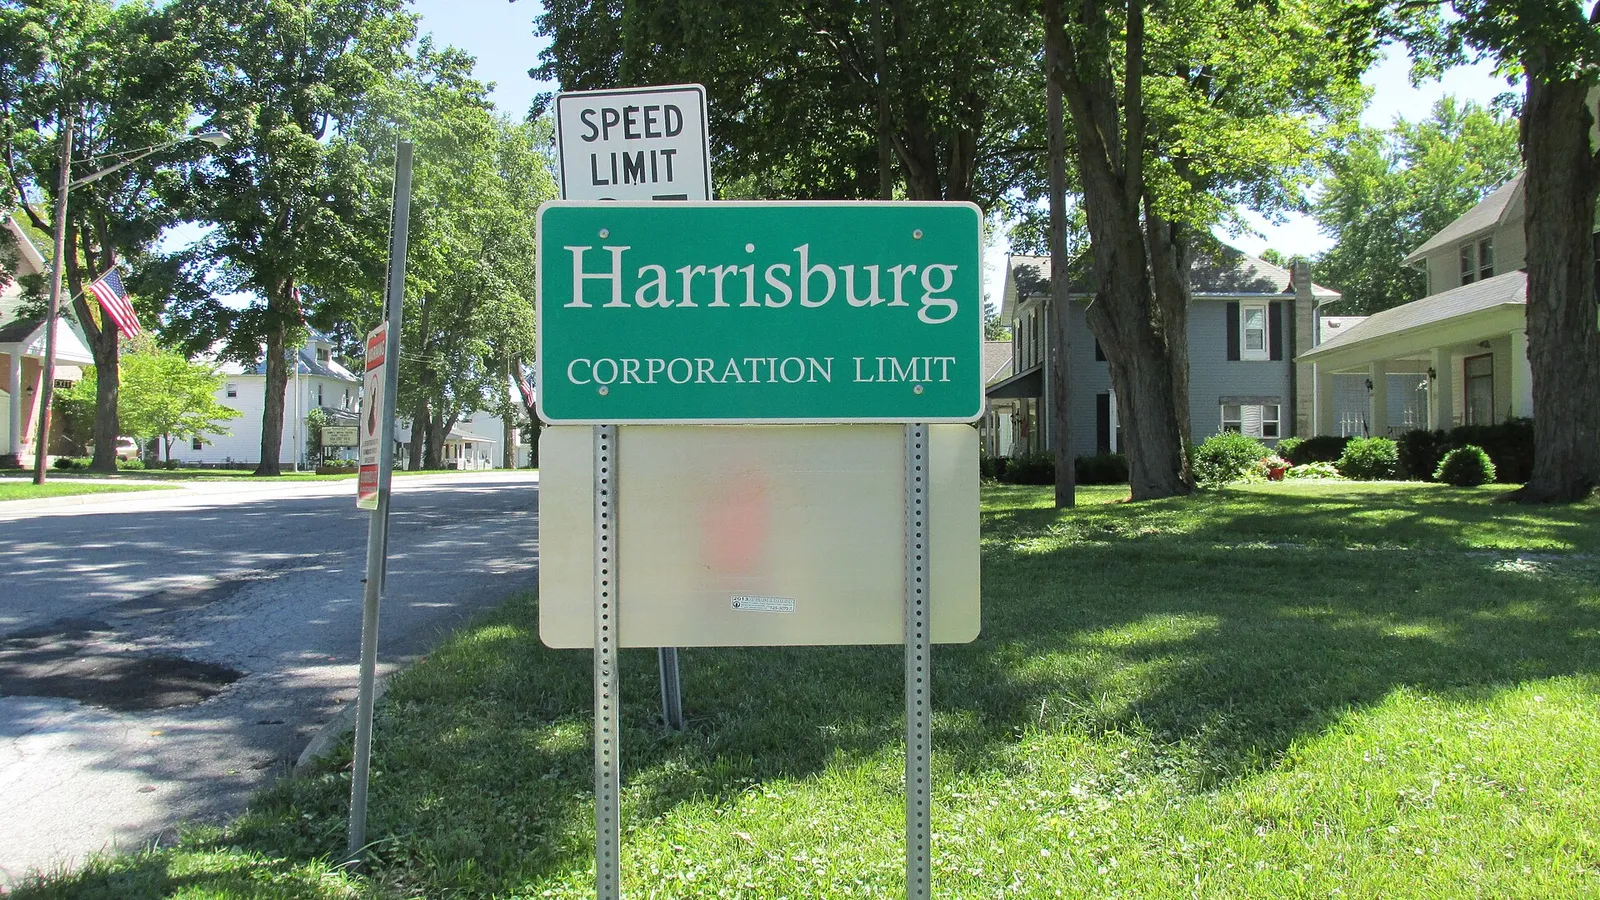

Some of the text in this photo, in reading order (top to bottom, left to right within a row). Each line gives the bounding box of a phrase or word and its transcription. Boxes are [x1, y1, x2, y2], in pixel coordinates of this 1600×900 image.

[580, 104, 684, 143] SPEED
[590, 149, 677, 186] LIMIT
[563, 243, 959, 325] Harrisburg
[55, 379, 71, 388] EXIT
[566, 356, 956, 386] CORPORATION LIMIT
